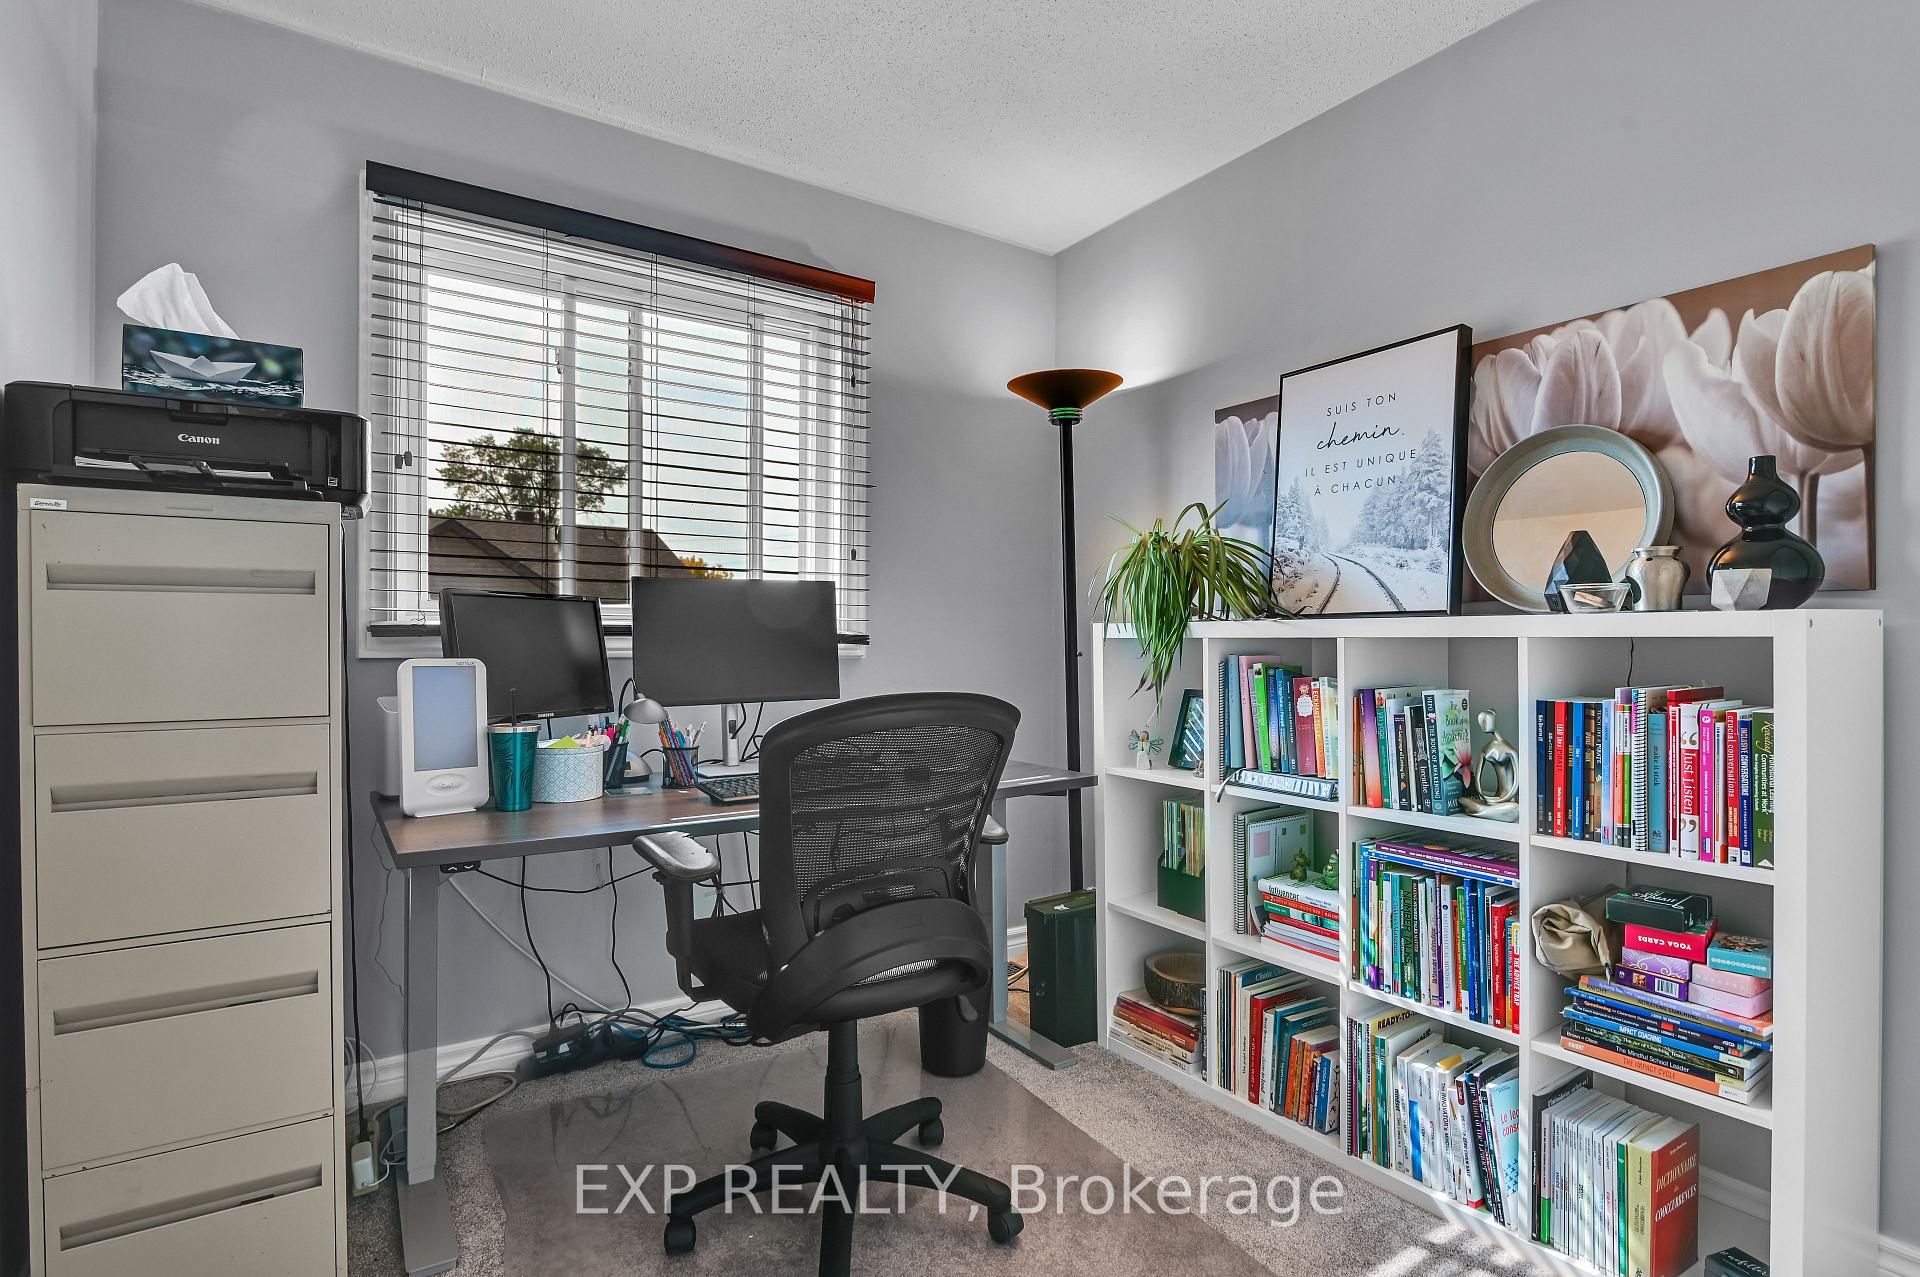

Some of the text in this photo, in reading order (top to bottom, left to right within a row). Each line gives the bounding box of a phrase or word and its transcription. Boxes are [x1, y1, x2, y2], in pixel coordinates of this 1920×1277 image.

[1326, 393, 1396, 416] SUIS TON
[177, 433, 220, 445] Canon
[1305, 449, 1416, 477] IL EST UNIQUE
[1331, 476, 1396, 494] CHACUN
[1728, 715, 1736, 742] crucial
[1756, 721, 1774, 754] Revisiting
[1420, 766, 1429, 794] breathe
[1682, 749, 1696, 814] Just Listen
[1728, 744, 1736, 798] conversations
[1741, 754, 1749, 796] CONVERSATIONS
[1762, 790, 1768, 798] at
[1404, 890, 1412, 964] NUMBER TALKS
[1638, 935, 1692, 951] YOGA CARDS
[1584, 1000, 1611, 1012] Questioning
[1619, 1026, 1636, 1036] IMPACT
[1638, 1031, 1662, 1044] COACHING
[1566, 1032, 1580, 1040] Brown
[1616, 1046, 1627, 1054] The
[1628, 1050, 1648, 1060] Mindful
[1650, 1055, 1668, 1066] School
[1670, 1062, 1690, 1073] Leader
[1623, 1058, 1632, 1066] THE
[1634, 1062, 1656, 1073] IMPACT
[1658, 1069, 1676, 1080] CYCLE
[1656, 1154, 1697, 1193] DICTIONNAIRE
[1655, 1184, 1697, 1222] COOCCURRENCES
